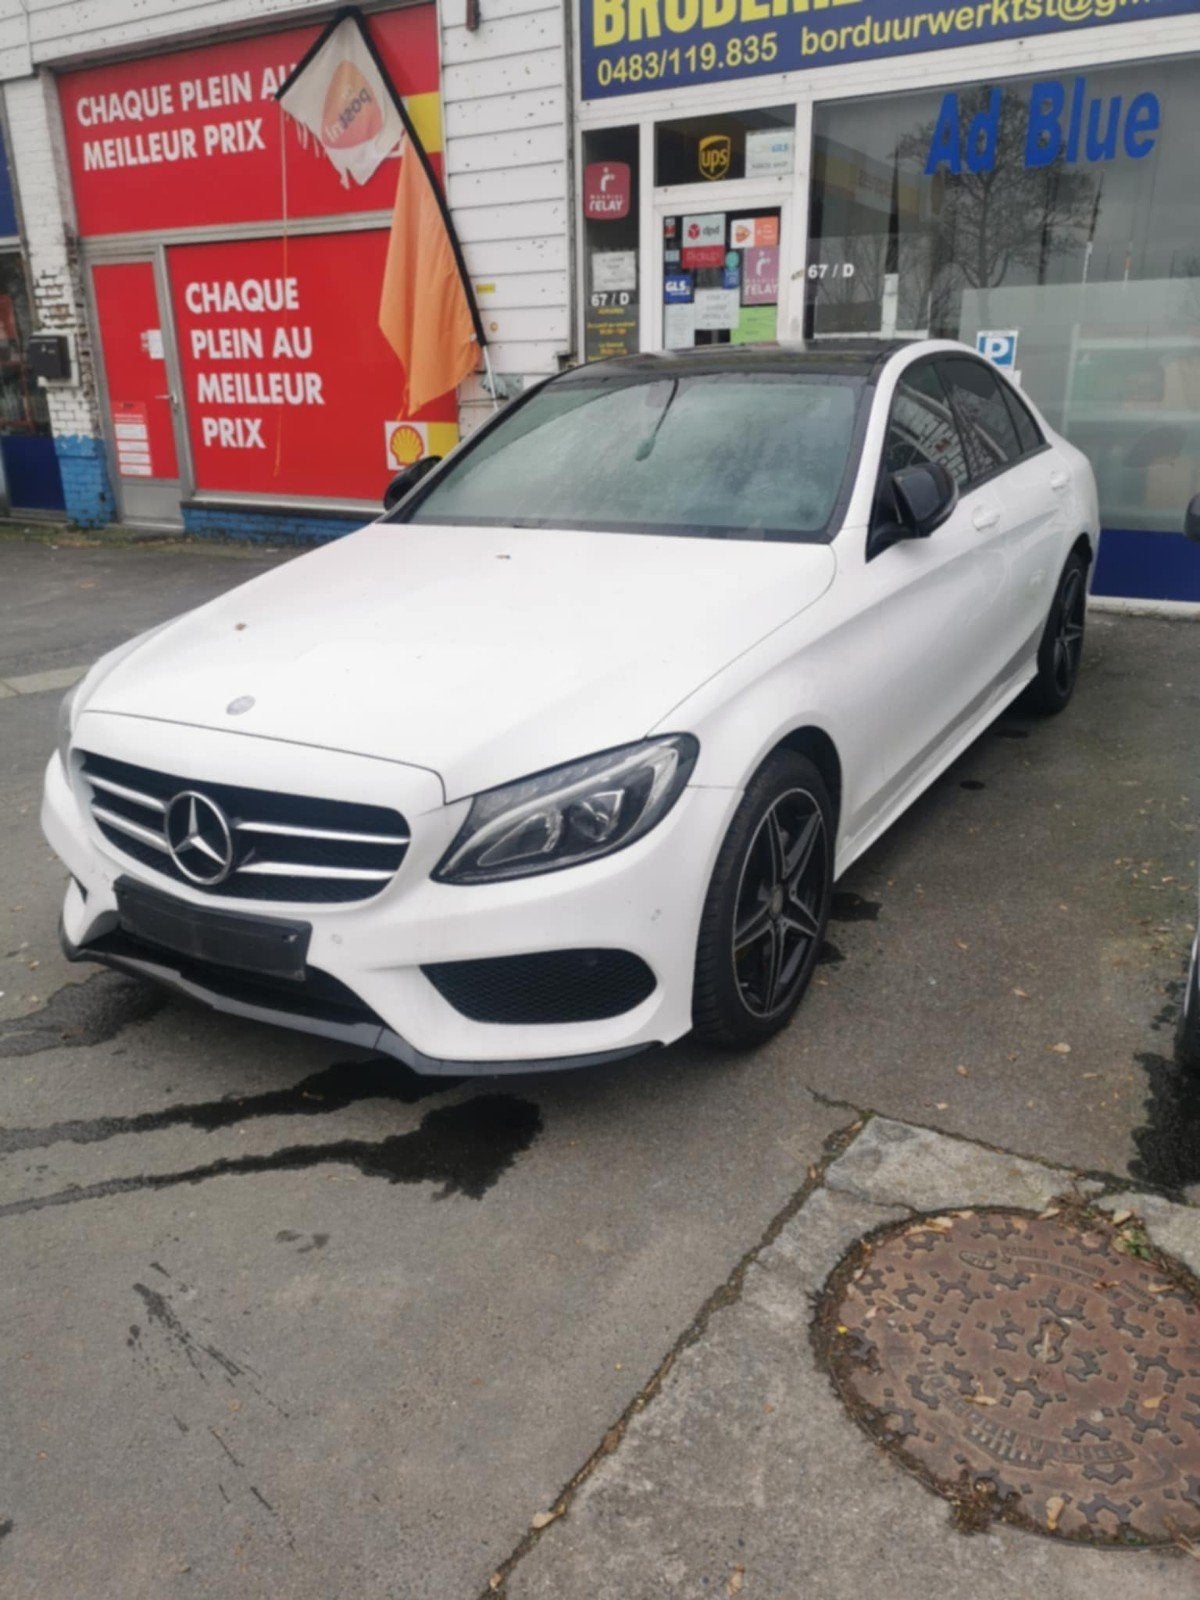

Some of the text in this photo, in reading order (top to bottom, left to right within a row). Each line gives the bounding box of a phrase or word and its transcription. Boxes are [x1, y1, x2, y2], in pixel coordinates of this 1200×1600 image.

[597, 32, 778, 86] 0483/119.835
[76, 84, 174, 127] CHAQUE
[180, 71, 252, 112] PLEIN
[924, 76, 1160, 175] Ad Blue
[83, 118, 266, 171] MEILLEUR PRIX
[701, 151, 728, 173] ups
[807, 264, 828, 278] 67
[842, 263, 855, 277] D
[185, 277, 300, 315] CHAQUE
[591, 293, 608, 307] 67
[620, 292, 630, 305] D
[190, 326, 313, 360] PLEIN AU
[197, 372, 326, 405] MEILLEUR
[202, 416, 267, 449] PRIX
